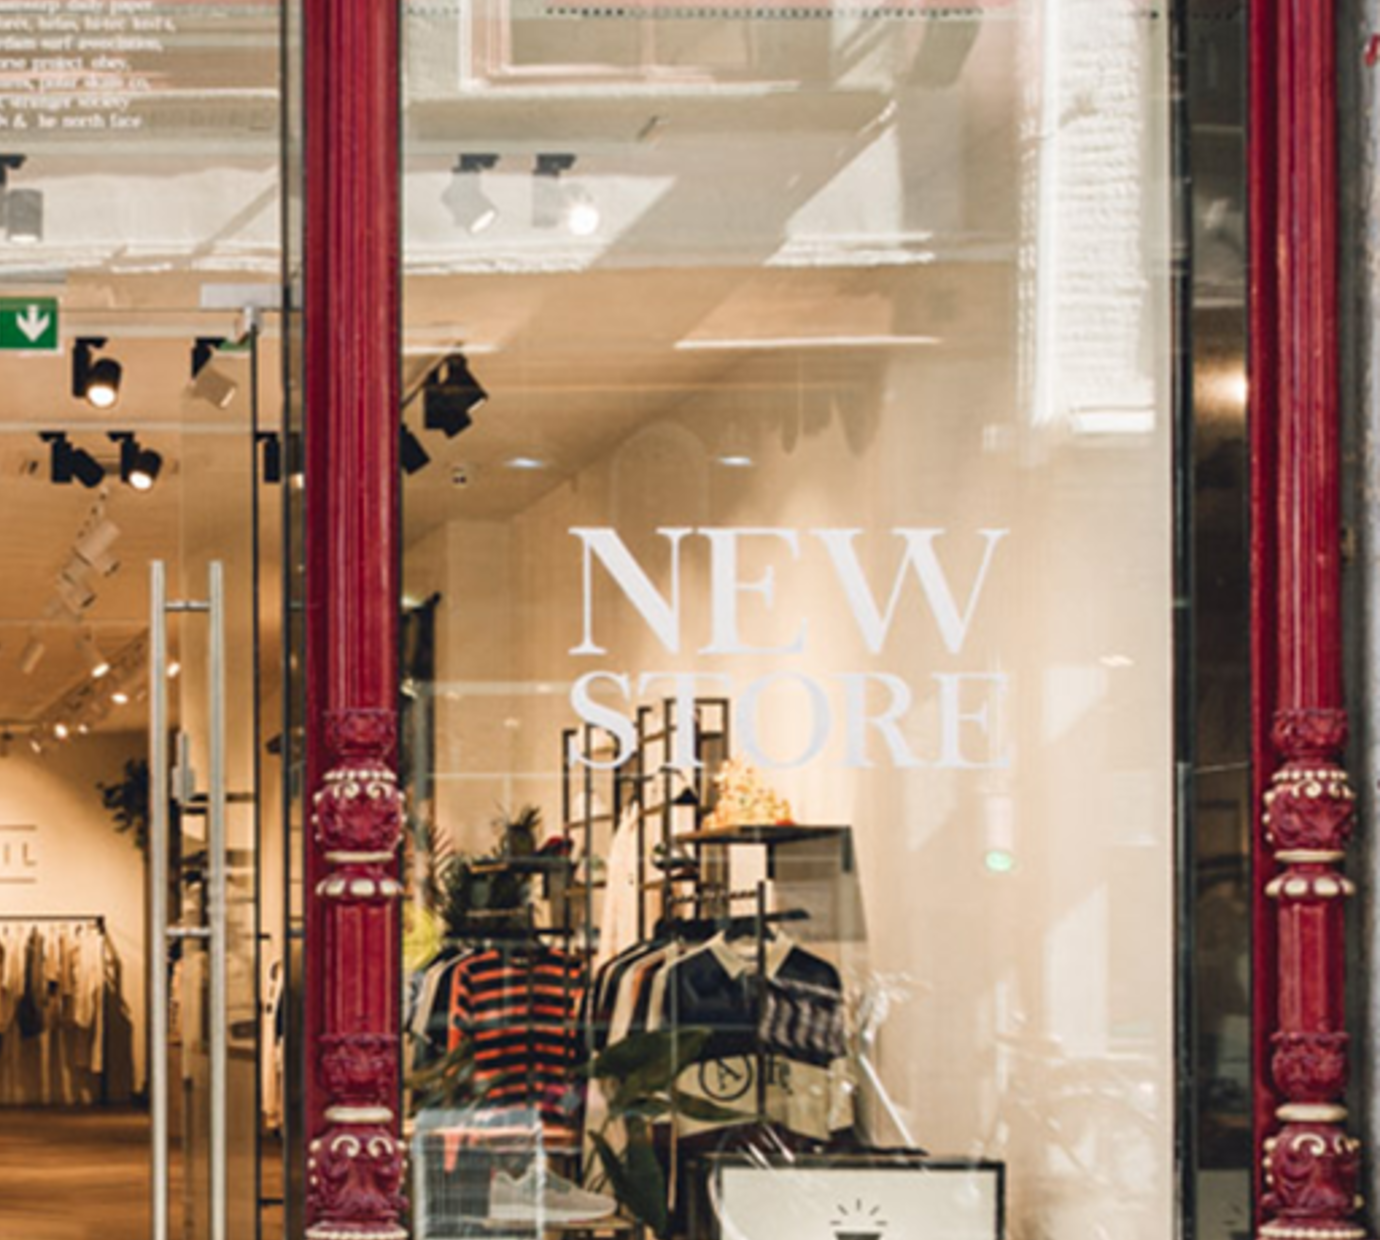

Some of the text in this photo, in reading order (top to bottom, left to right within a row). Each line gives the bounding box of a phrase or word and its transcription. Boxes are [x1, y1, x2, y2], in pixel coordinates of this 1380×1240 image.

[40, 35, 74, 51] surf
[12, 113, 27, 129] &
[61, 113, 106, 128] north
[109, 113, 143, 128] face
[568, 527, 1011, 656] NEW
[569, 671, 1011, 770] STORE
